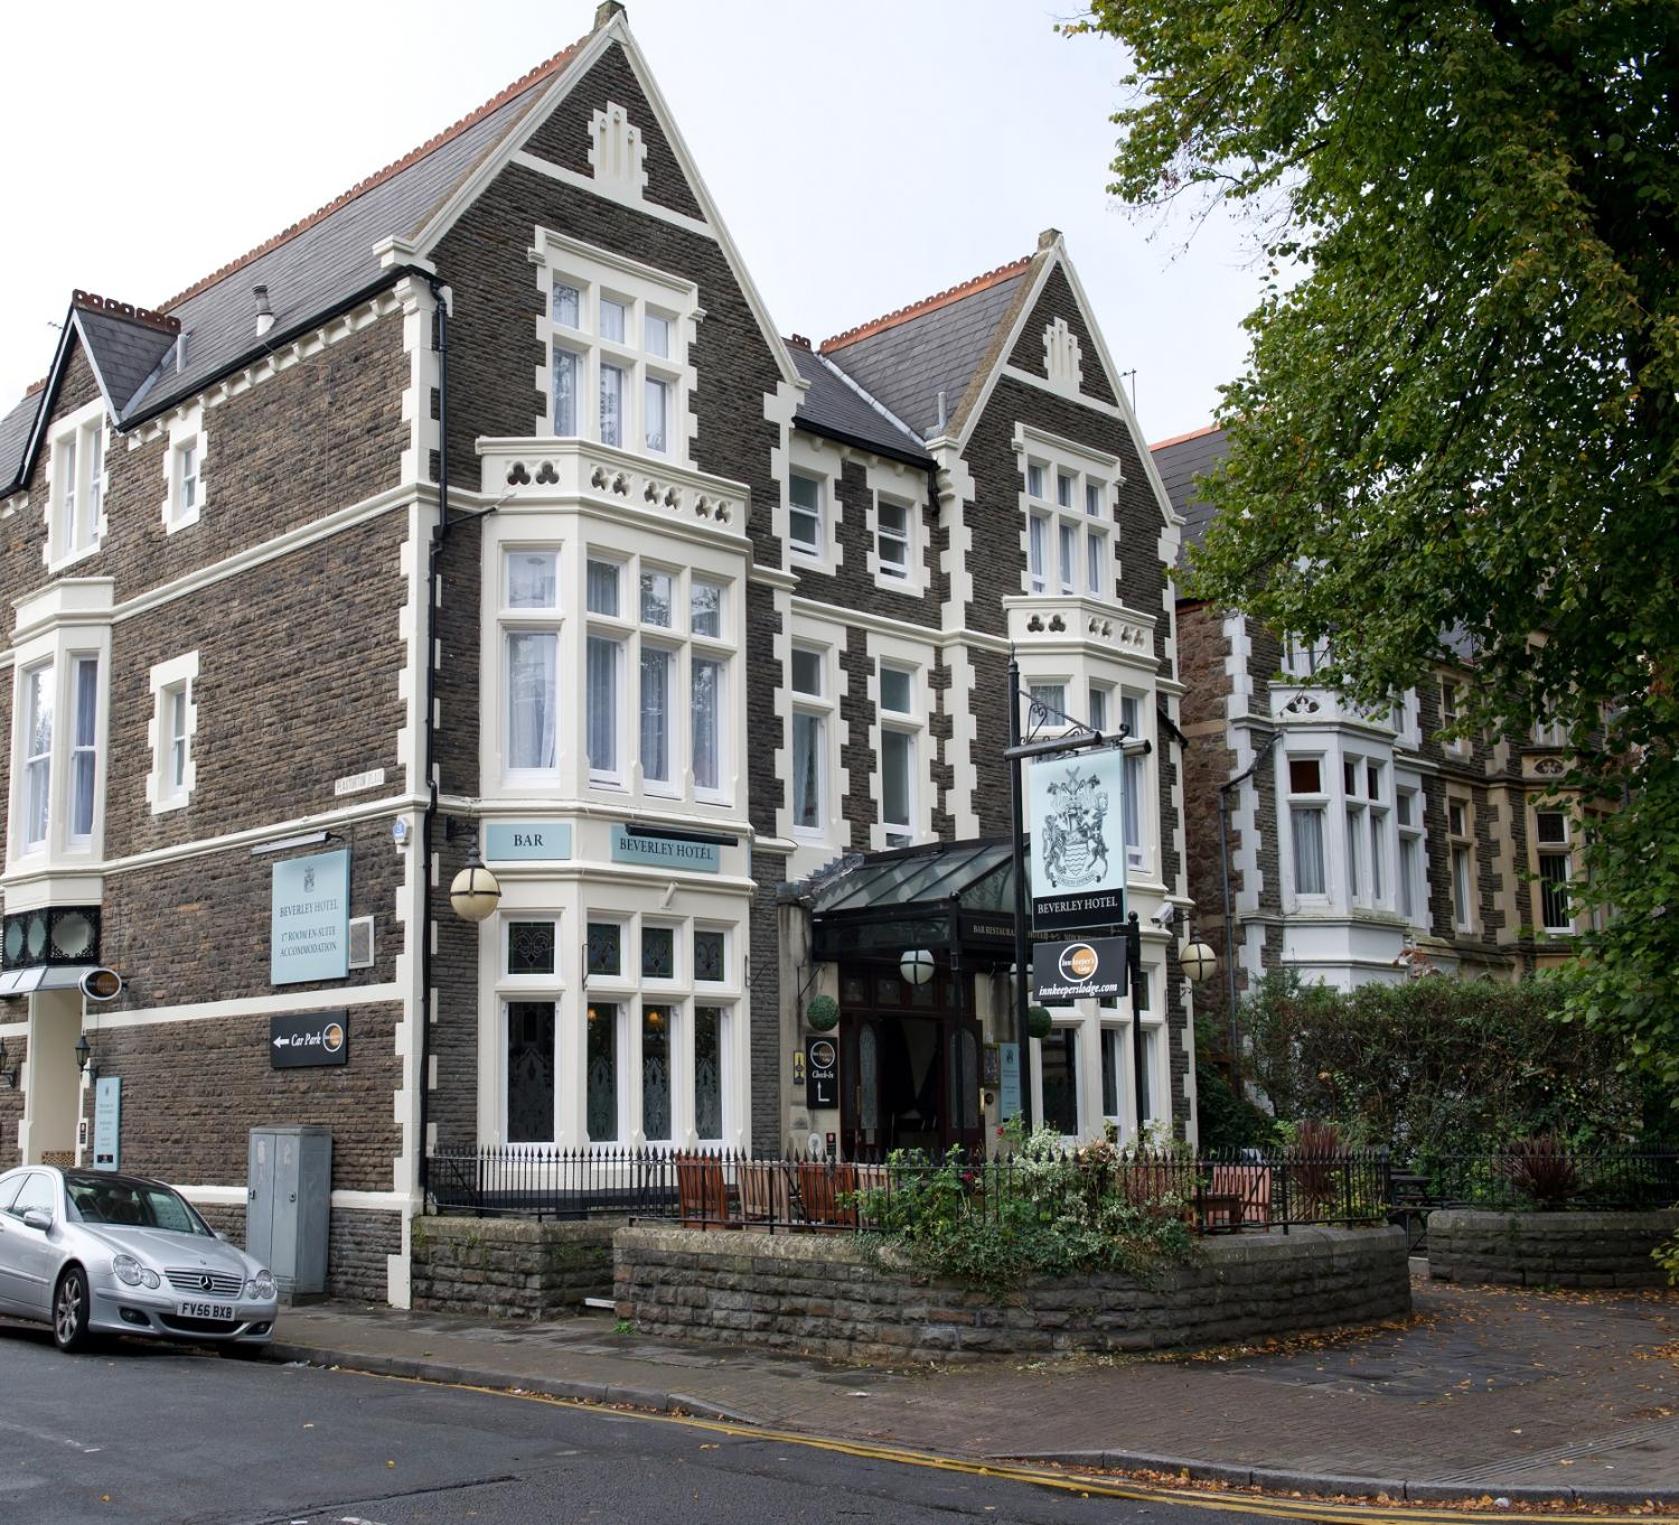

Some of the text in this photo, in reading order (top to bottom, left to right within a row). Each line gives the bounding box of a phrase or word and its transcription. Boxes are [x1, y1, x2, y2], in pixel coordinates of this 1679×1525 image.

[513, 833, 544, 847] BAR
[619, 838, 713, 861] BEVERLEY HOTEL
[280, 899, 338, 918] BEVERLEY HOTEL
[1037, 896, 1118, 915] BEVERLEY HOTEL
[288, 929, 308, 941] ROOM
[973, 925, 985, 934] BAR
[985, 926, 1016, 937] RESTAURA
[280, 942, 337, 957] ACCOMMODATION
[1039, 981, 1118, 998] innkeeperslodge.com
[291, 1033, 304, 1047] Car
[304, 1031, 321, 1046] Park
[182, 1302, 233, 1319] FV56 BXB
